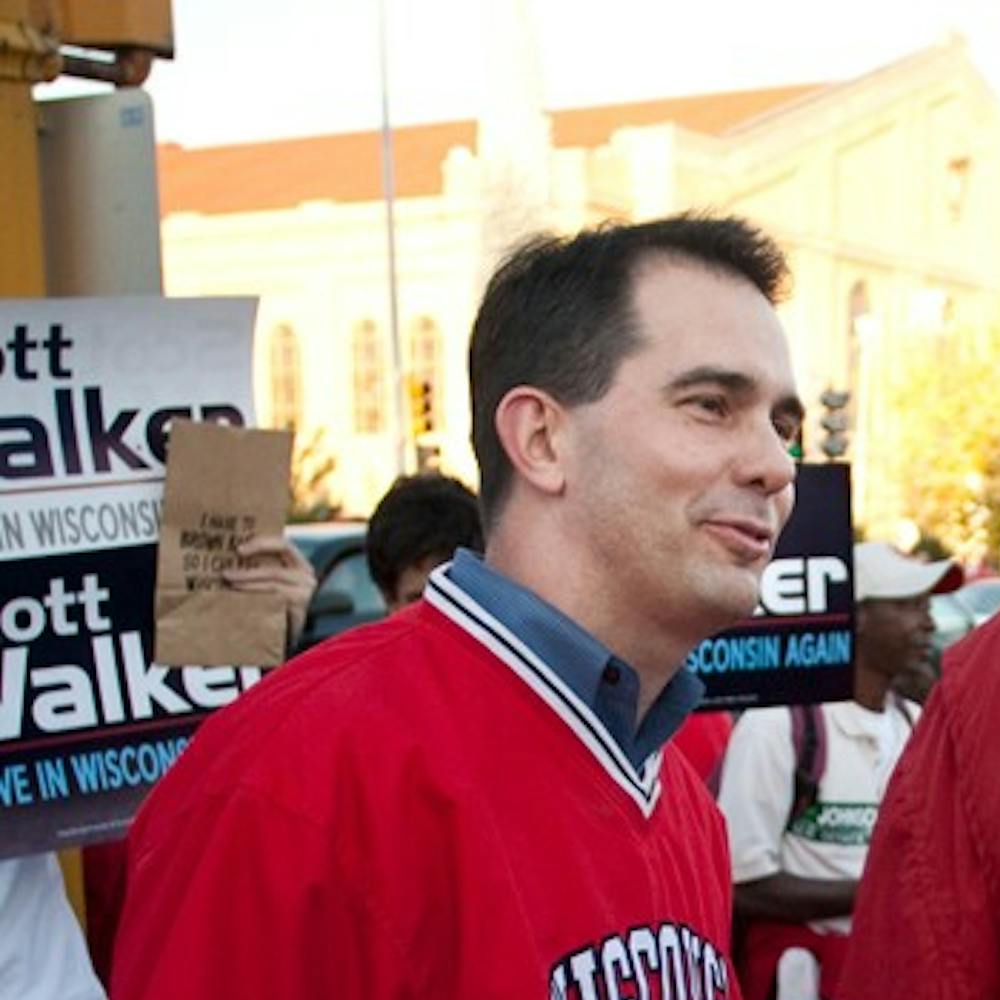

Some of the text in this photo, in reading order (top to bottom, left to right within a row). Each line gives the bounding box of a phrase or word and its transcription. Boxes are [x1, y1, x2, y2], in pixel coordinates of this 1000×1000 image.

[0, 324, 73, 380] tt
[29, 499, 164, 548] WISCONSI
[0, 573, 112, 642] ott
[753, 556, 848, 616] er
[784, 630, 850, 668] AGAIN
[35, 758, 68, 800] IN
